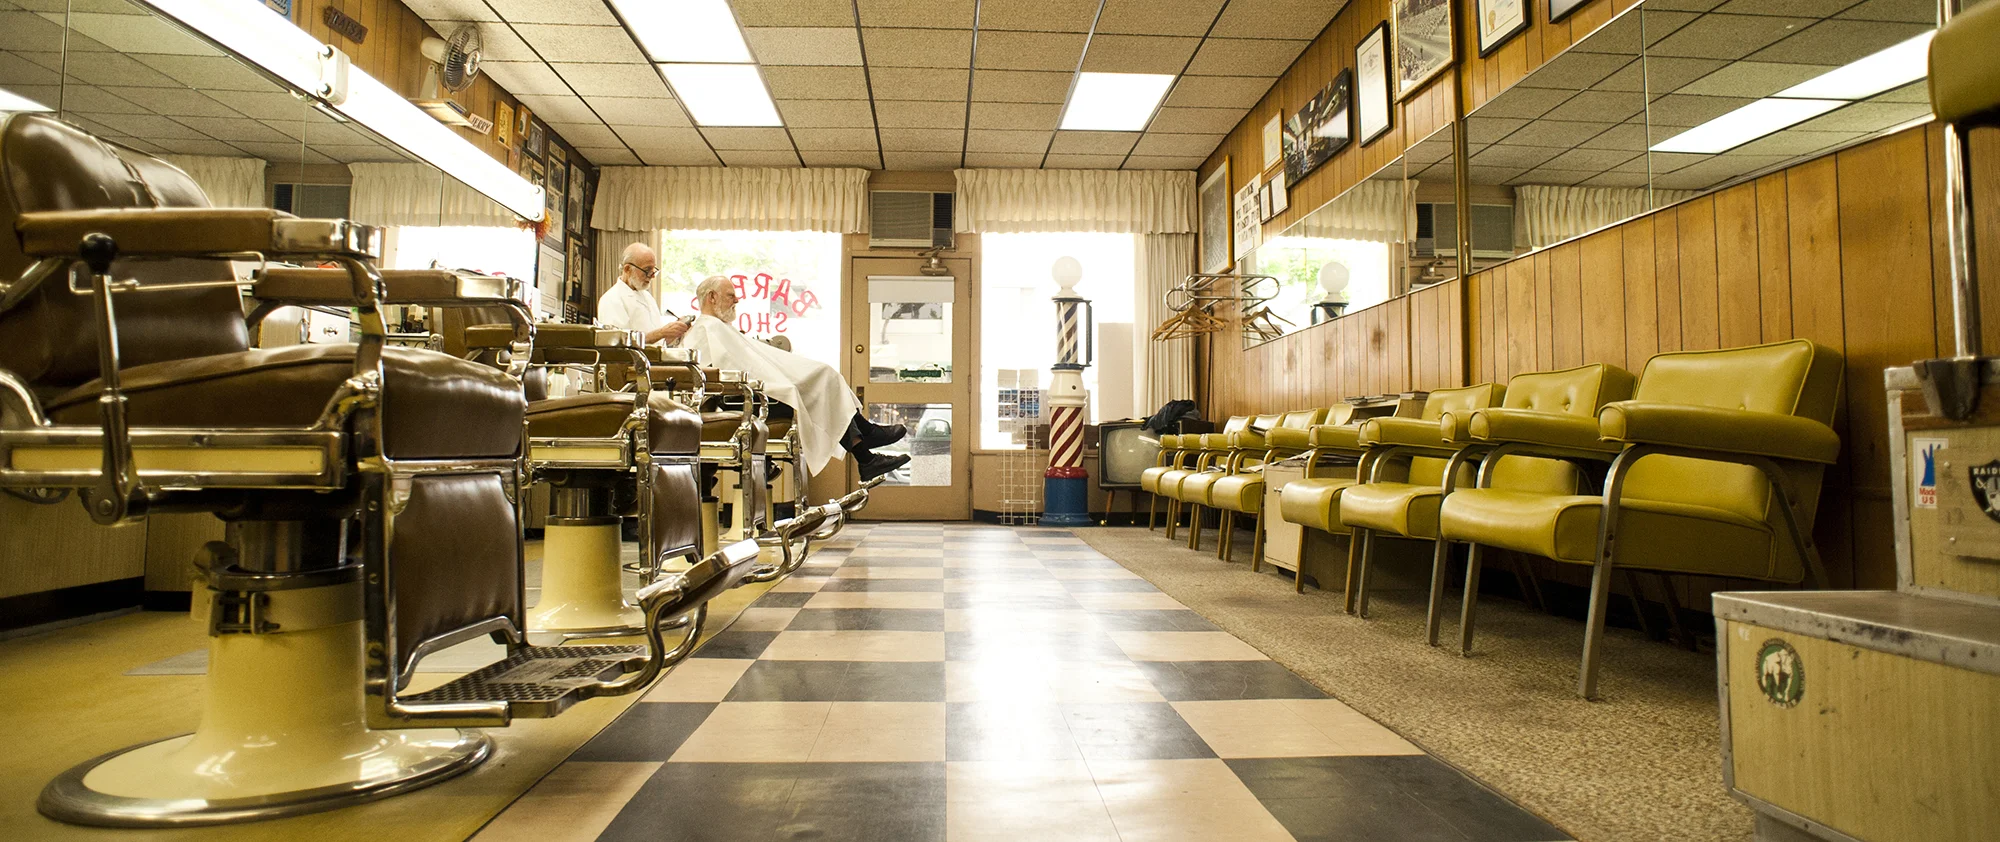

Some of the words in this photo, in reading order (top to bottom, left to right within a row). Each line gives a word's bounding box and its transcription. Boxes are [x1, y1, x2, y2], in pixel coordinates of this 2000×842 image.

[471, 116, 491, 133] JERRY
[1973, 467, 2000, 476] RAID
[1919, 487, 1936, 496] Made
[1922, 496, 1935, 505] US
